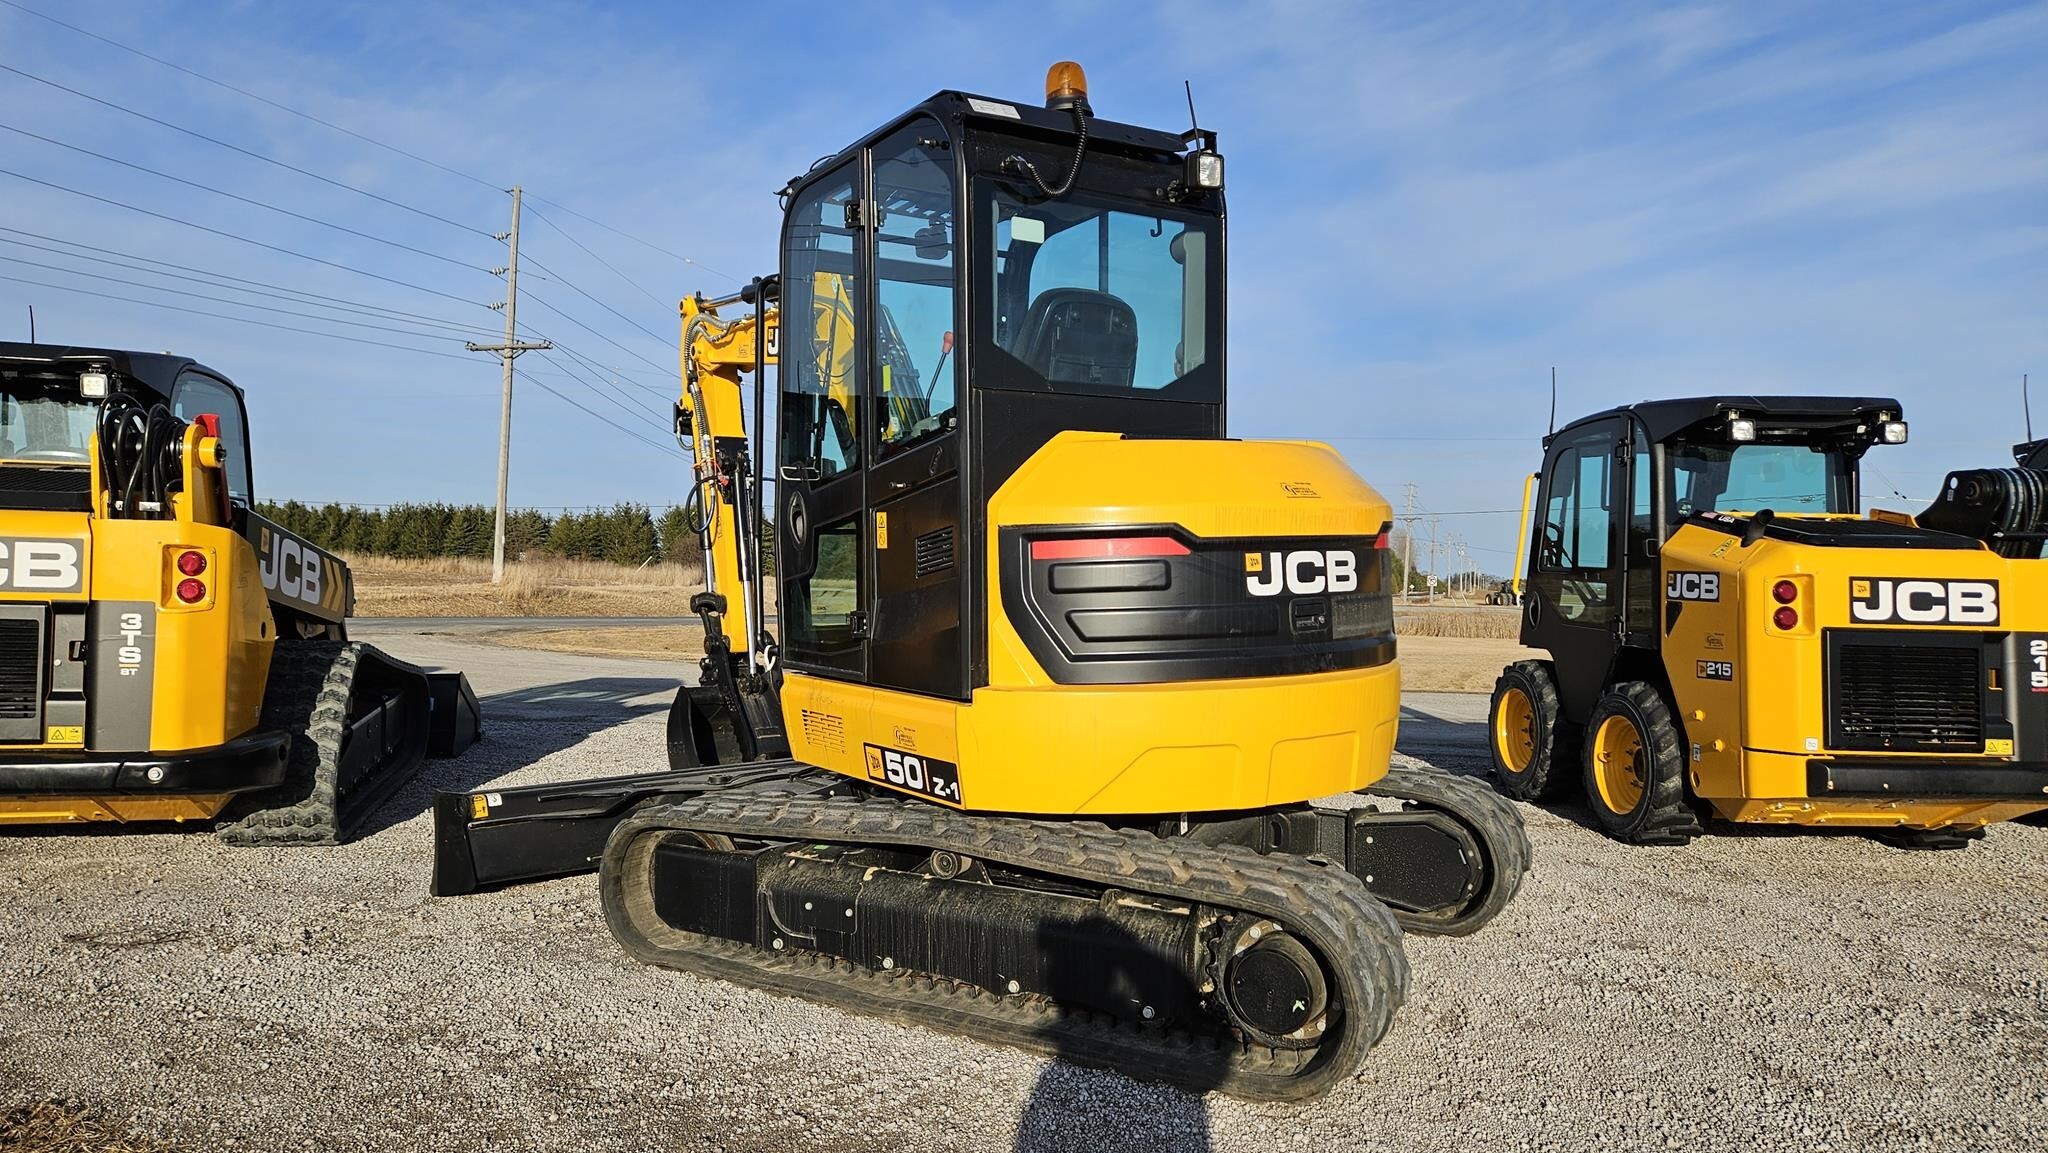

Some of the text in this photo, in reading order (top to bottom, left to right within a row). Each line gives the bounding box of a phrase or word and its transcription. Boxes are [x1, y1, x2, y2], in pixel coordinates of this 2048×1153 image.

[259, 532, 321, 604] JCB
[1246, 550, 1357, 596] JCB
[1667, 573, 1718, 599] JCB
[1852, 580, 1998, 623] JCB
[1706, 662, 1731, 676] 215
[2030, 640, 2048, 687] 215
[884, 750, 923, 789] 50
